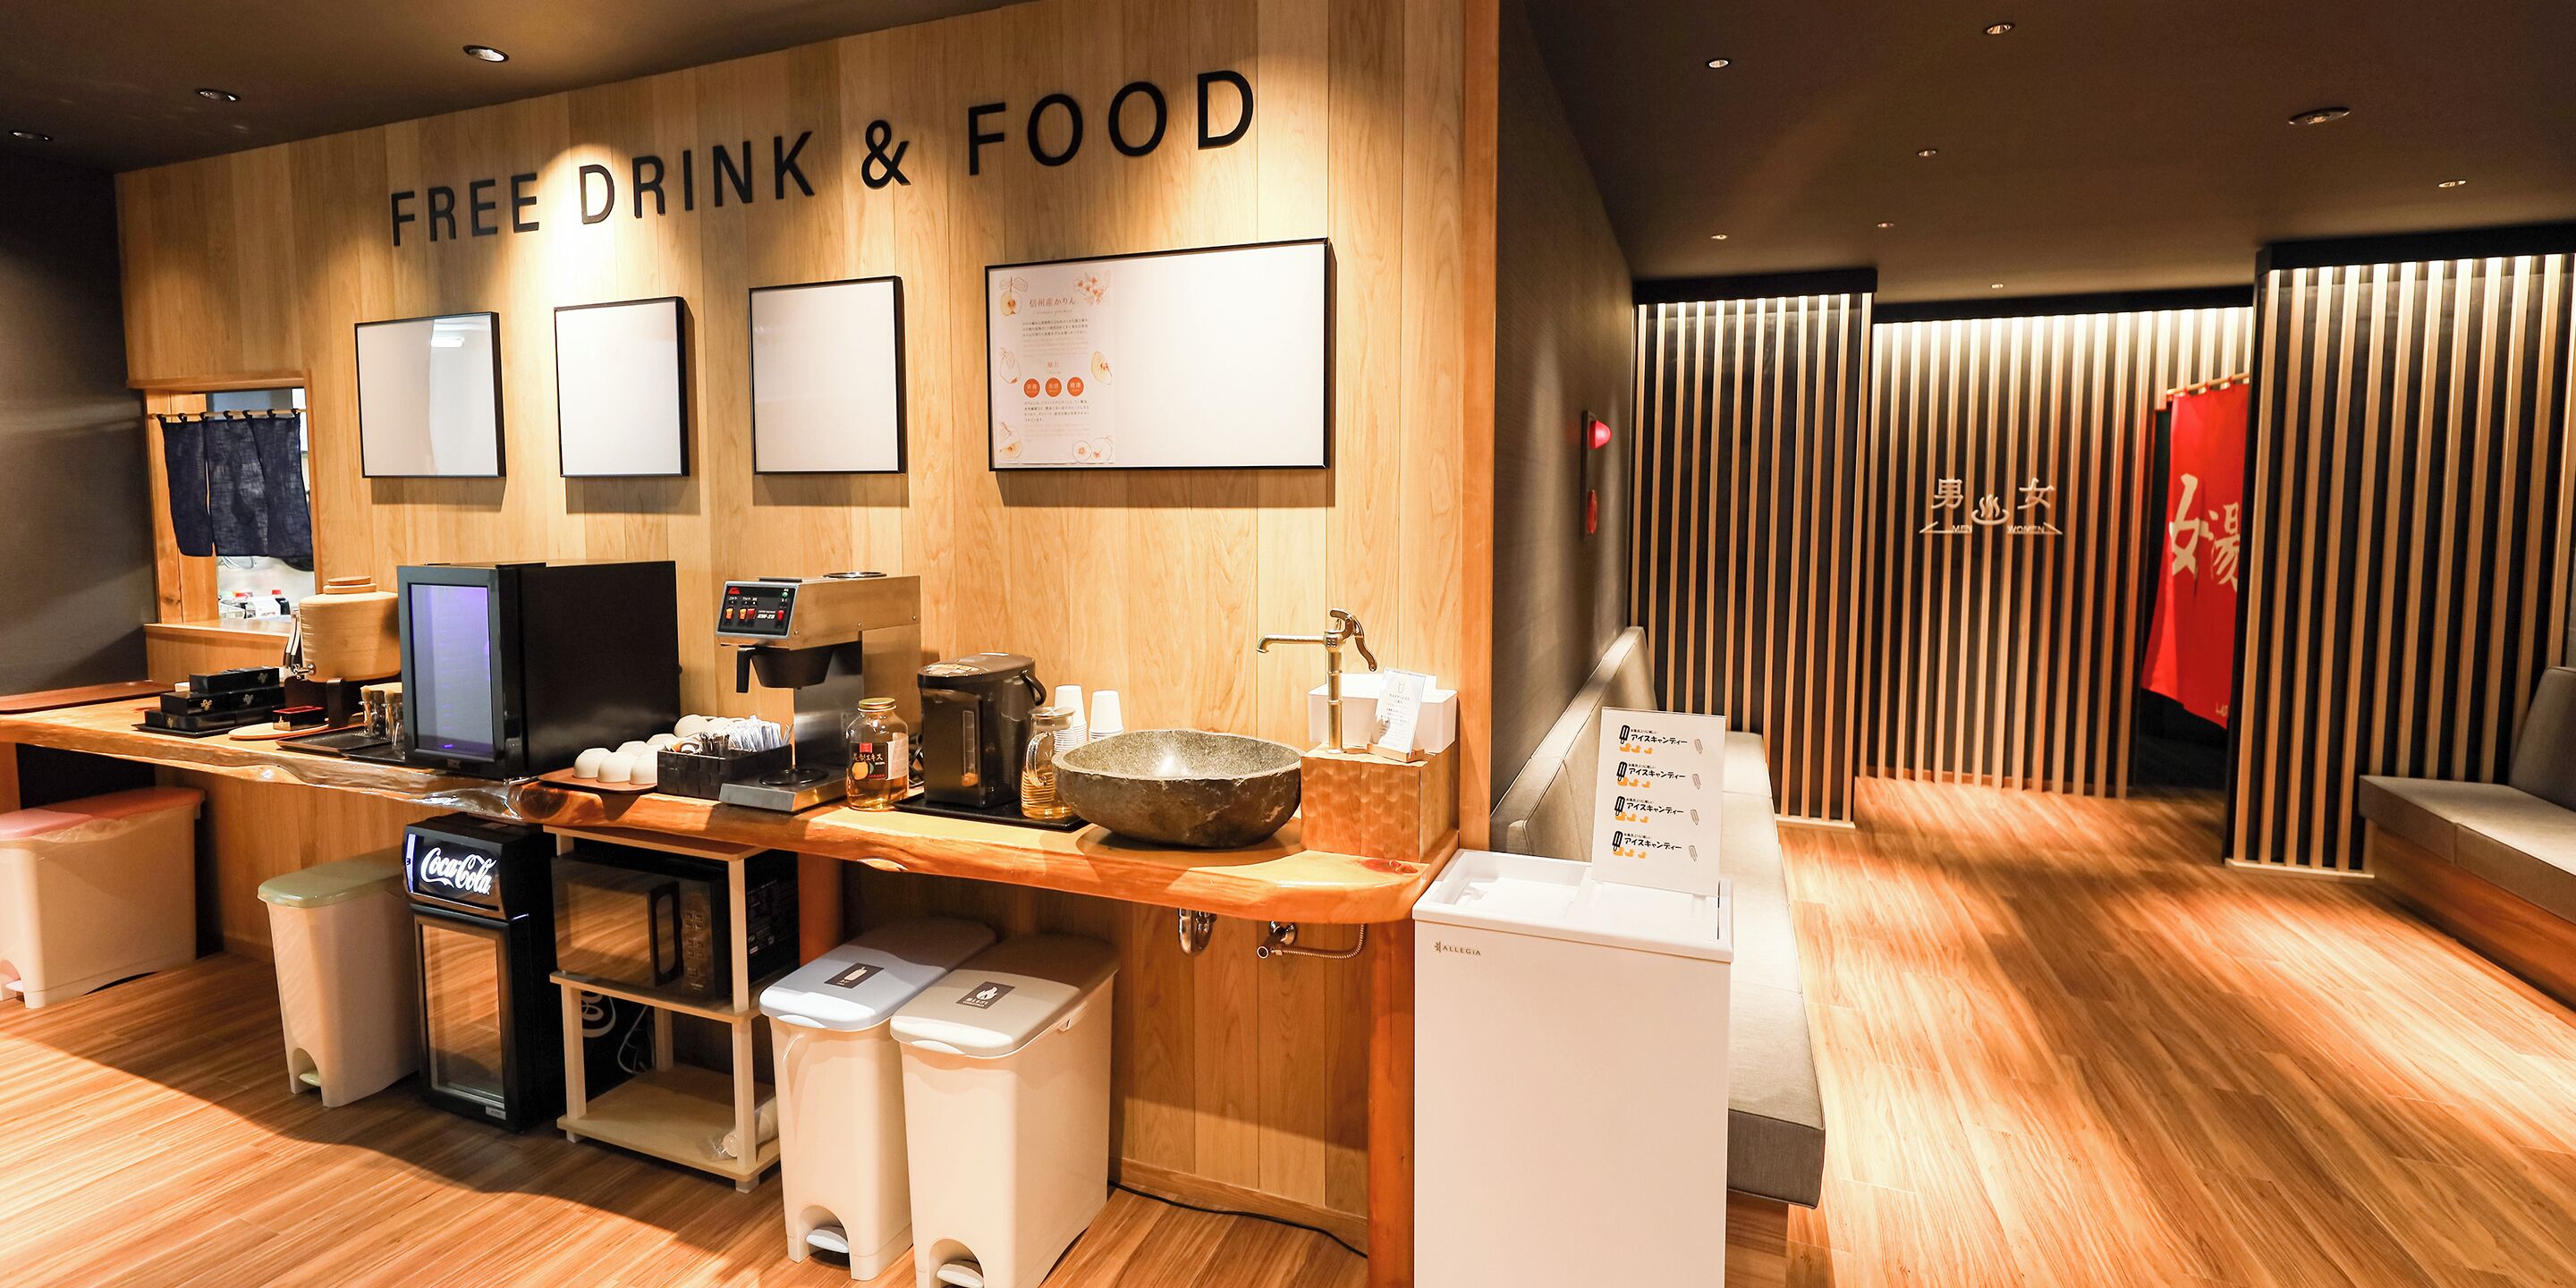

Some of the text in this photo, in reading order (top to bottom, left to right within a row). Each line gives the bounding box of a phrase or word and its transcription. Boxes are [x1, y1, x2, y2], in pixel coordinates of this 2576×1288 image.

[391, 70, 1254, 247] FREE DRINK & FOOD
[1931, 477, 2055, 510] 男 女
[1952, 525, 2045, 534] MEN WOMEN
[2169, 473, 2241, 593] 女湯
[1631, 734, 1688, 745] アイスキャンディー
[1629, 767, 1686, 779] アイスキャンディー
[1627, 802, 1684, 815] アイスキャンディー
[1624, 838, 1682, 851] アイスキャンディー
[420, 847, 497, 895] Coca-Cola
[1443, 945, 1481, 956] ALLEGIA
